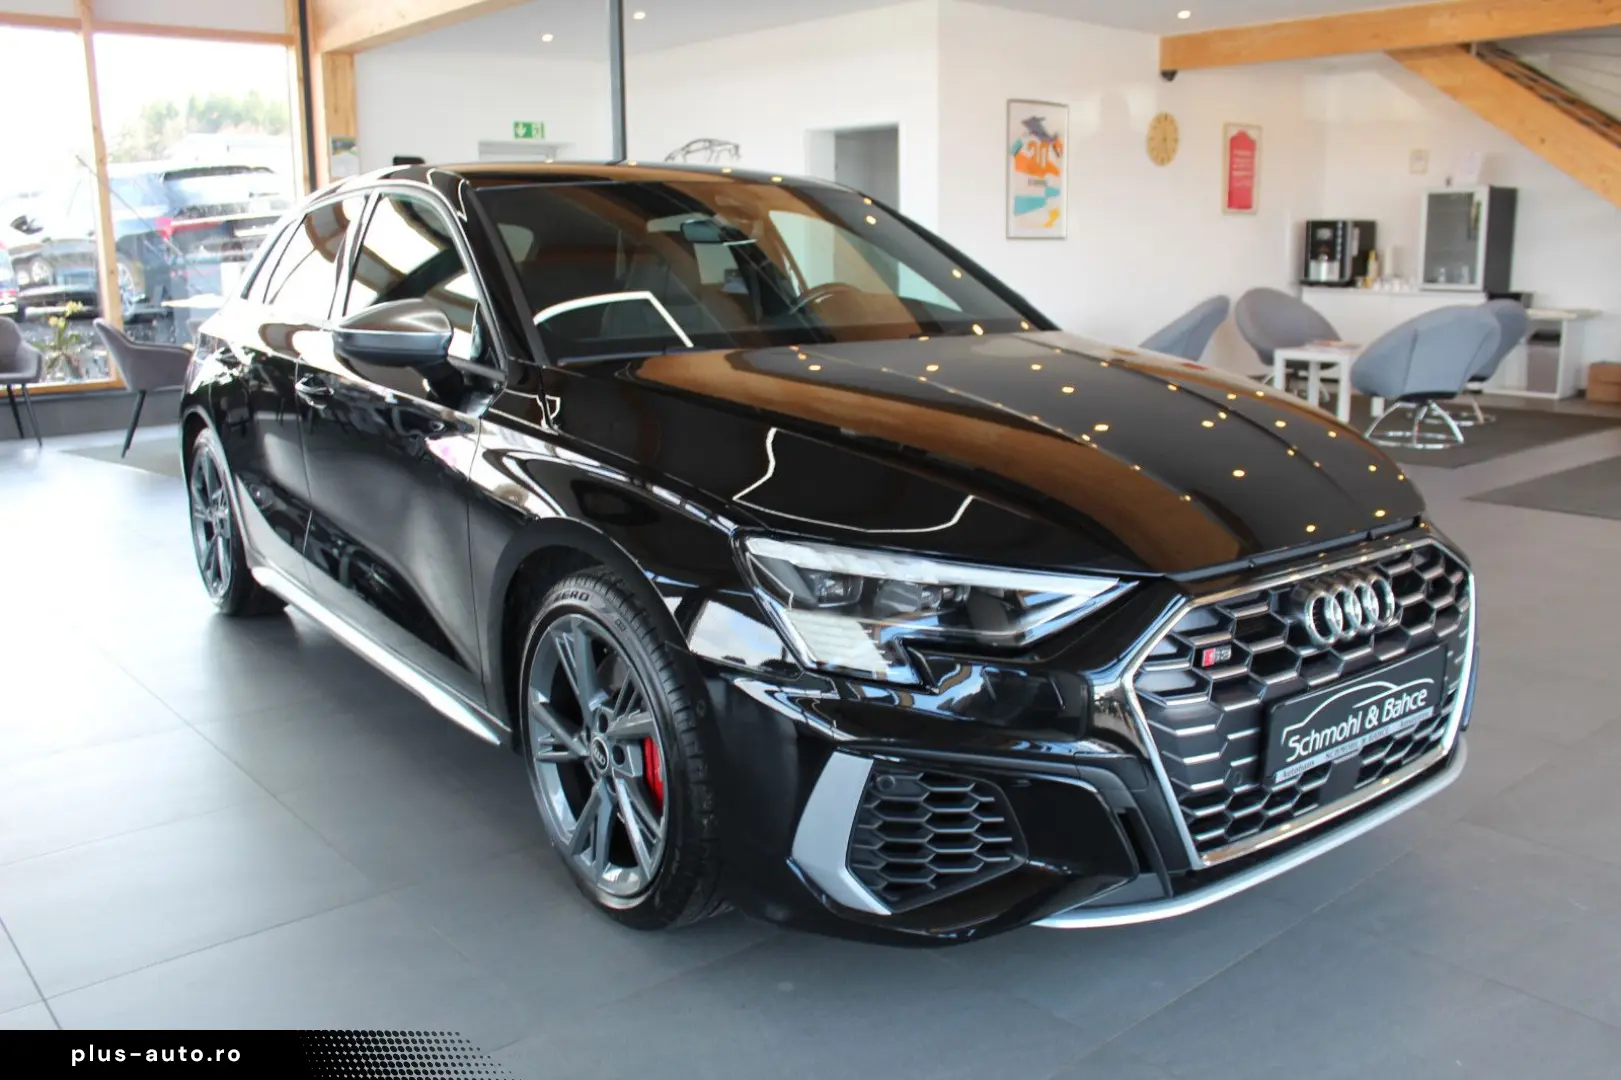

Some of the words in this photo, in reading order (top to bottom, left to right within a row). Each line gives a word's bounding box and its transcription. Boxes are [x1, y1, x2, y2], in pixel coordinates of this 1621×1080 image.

[1286, 711, 1363, 763] Schmohl
[1365, 705, 1379, 729] &
[1382, 688, 1428, 723] Bahce
